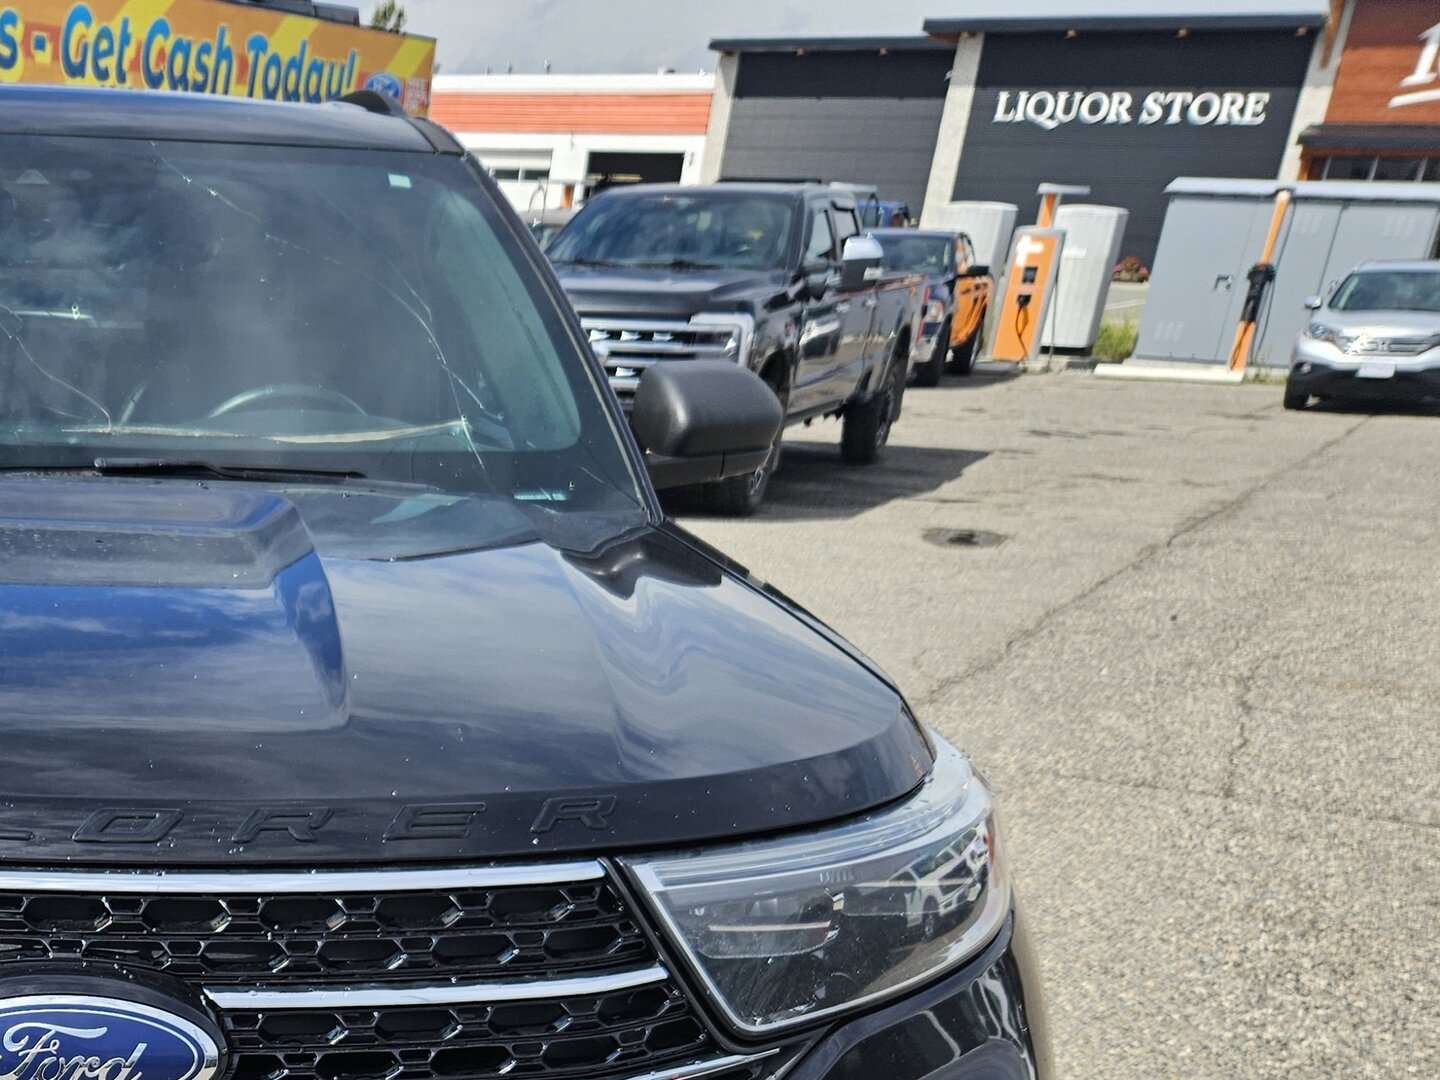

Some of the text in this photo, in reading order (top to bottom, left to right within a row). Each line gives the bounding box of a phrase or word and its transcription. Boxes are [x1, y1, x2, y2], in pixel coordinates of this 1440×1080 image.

[61, 4, 132, 84] Get
[141, 18, 234, 96] Cash
[246, 33, 357, 104] Today!
[992, 91, 1271, 130] LIQUOR STORE
